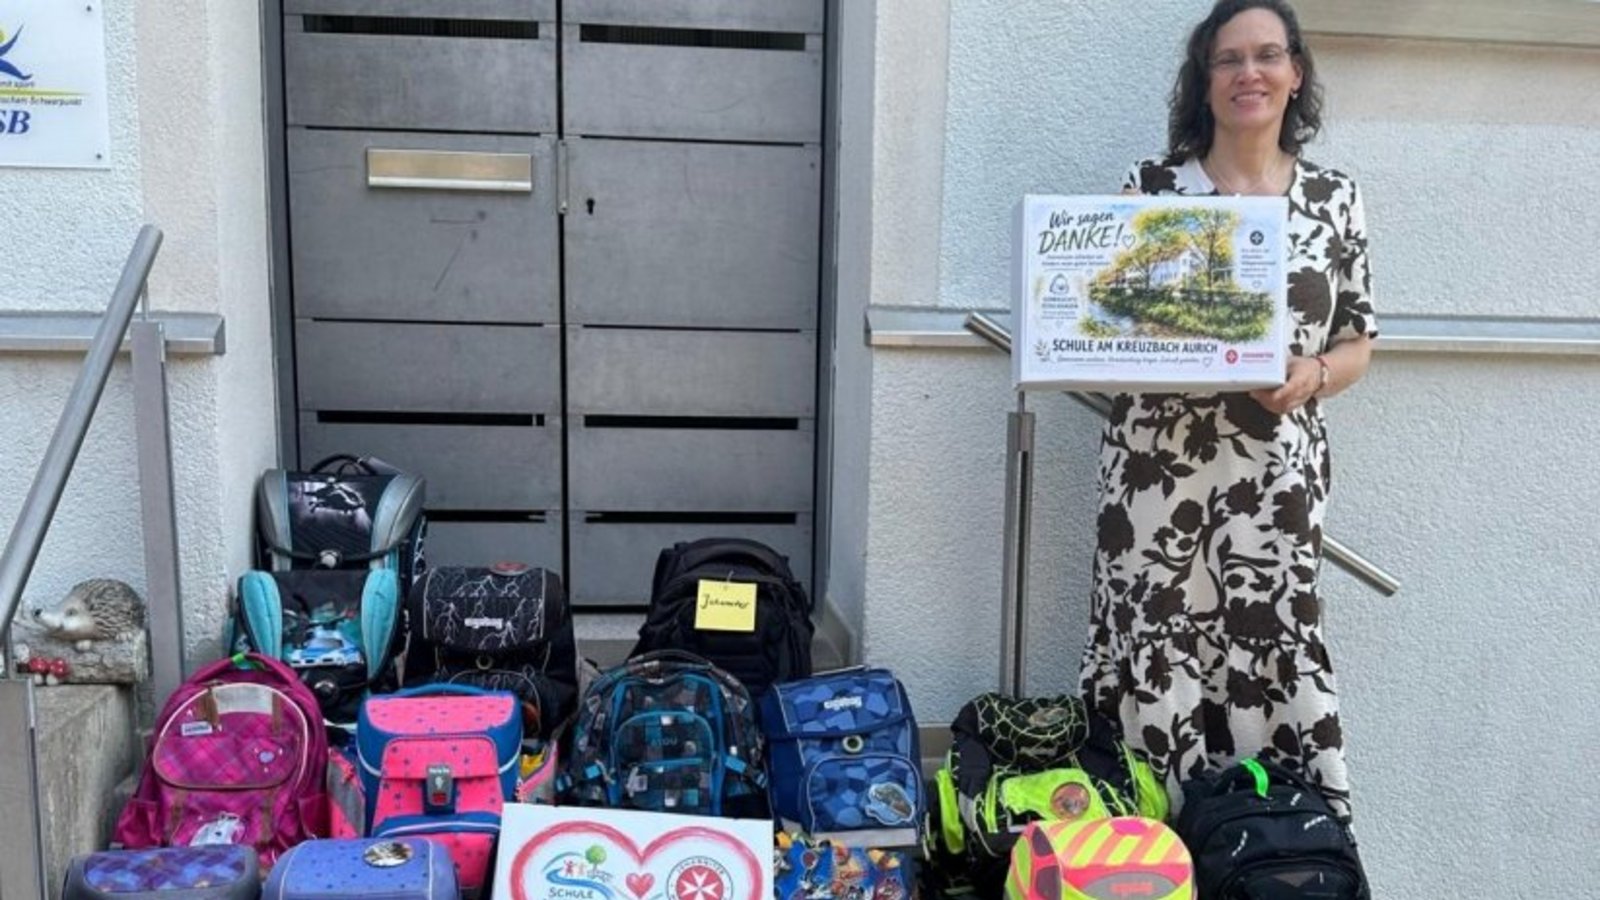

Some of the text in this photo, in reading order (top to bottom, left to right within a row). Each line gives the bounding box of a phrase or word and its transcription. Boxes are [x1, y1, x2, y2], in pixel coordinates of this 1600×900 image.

[1049, 209, 1114, 229] Wir sagen
[1038, 222, 1124, 255] DANKE!
[1052, 338, 1218, 353] SCHULE AM KREUZBACH AURICH
[548, 886, 594, 899] SCHULE
